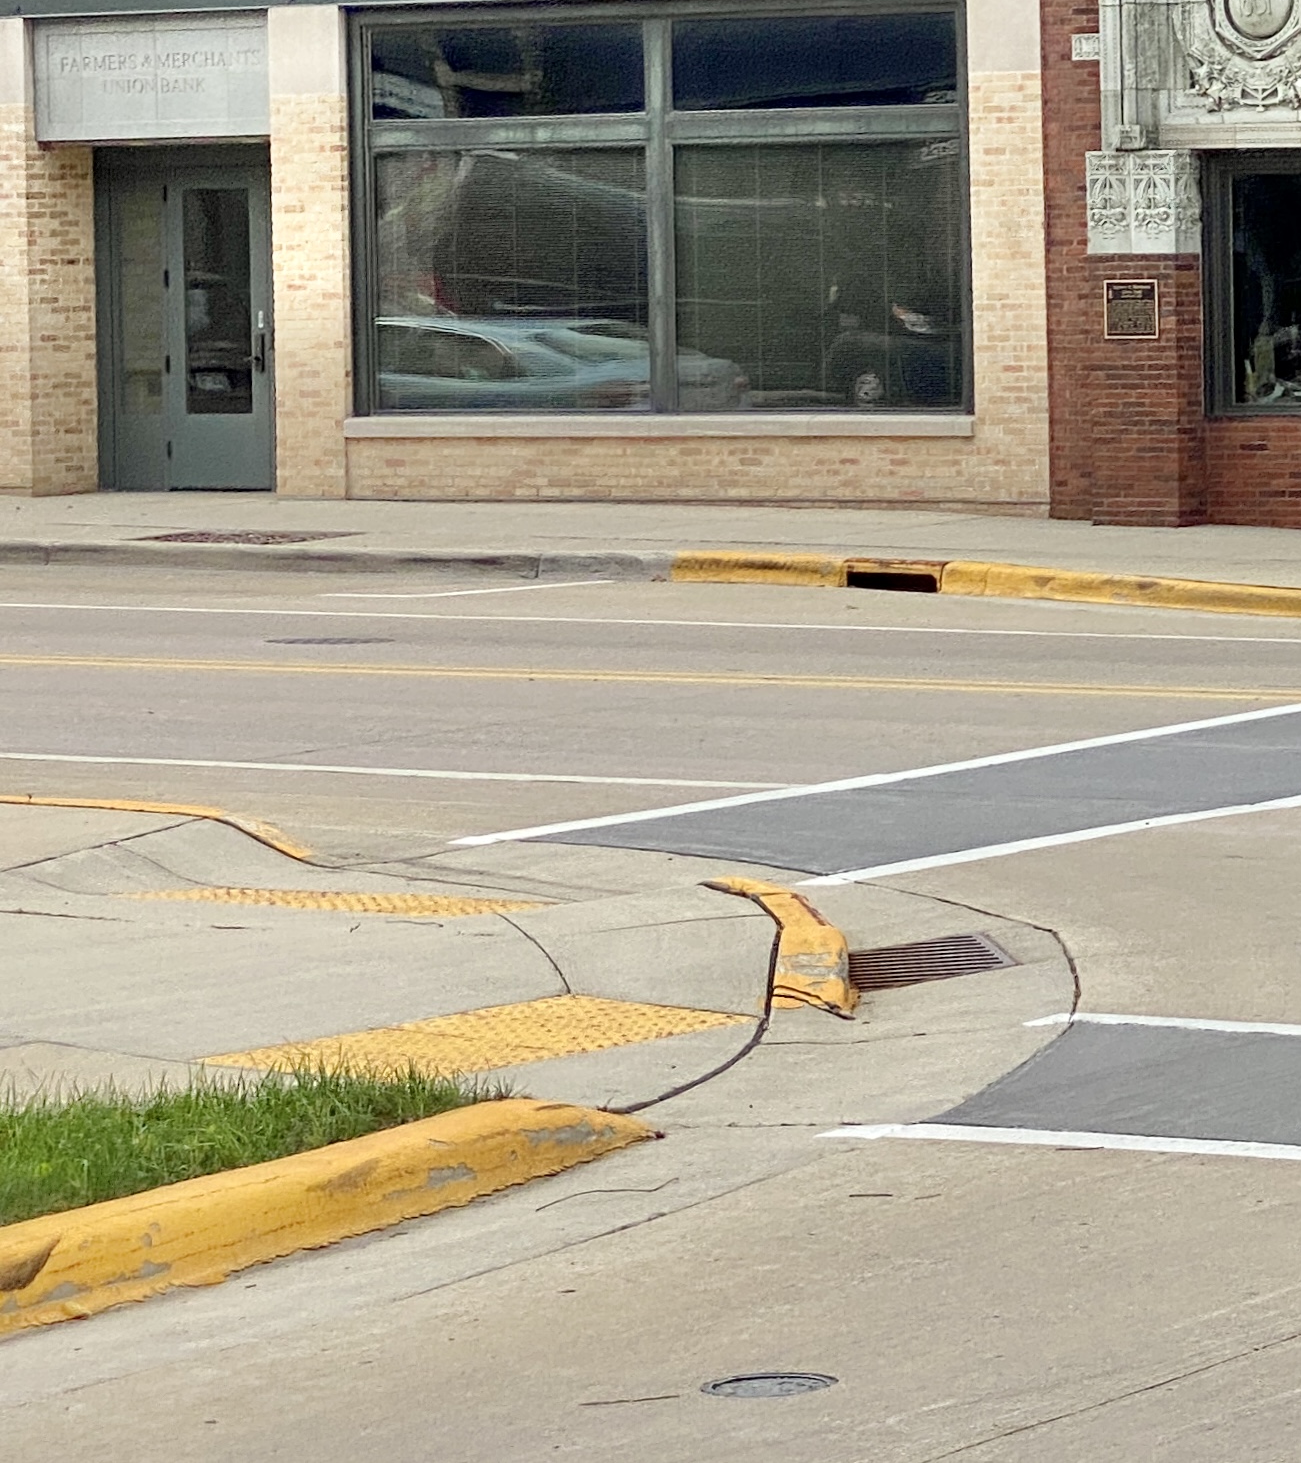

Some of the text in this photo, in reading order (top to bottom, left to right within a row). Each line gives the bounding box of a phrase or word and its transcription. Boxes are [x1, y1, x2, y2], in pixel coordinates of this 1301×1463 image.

[60, 49, 262, 73] FARMERS & MERCHANTS
[102, 77, 206, 94] UNION BANK
